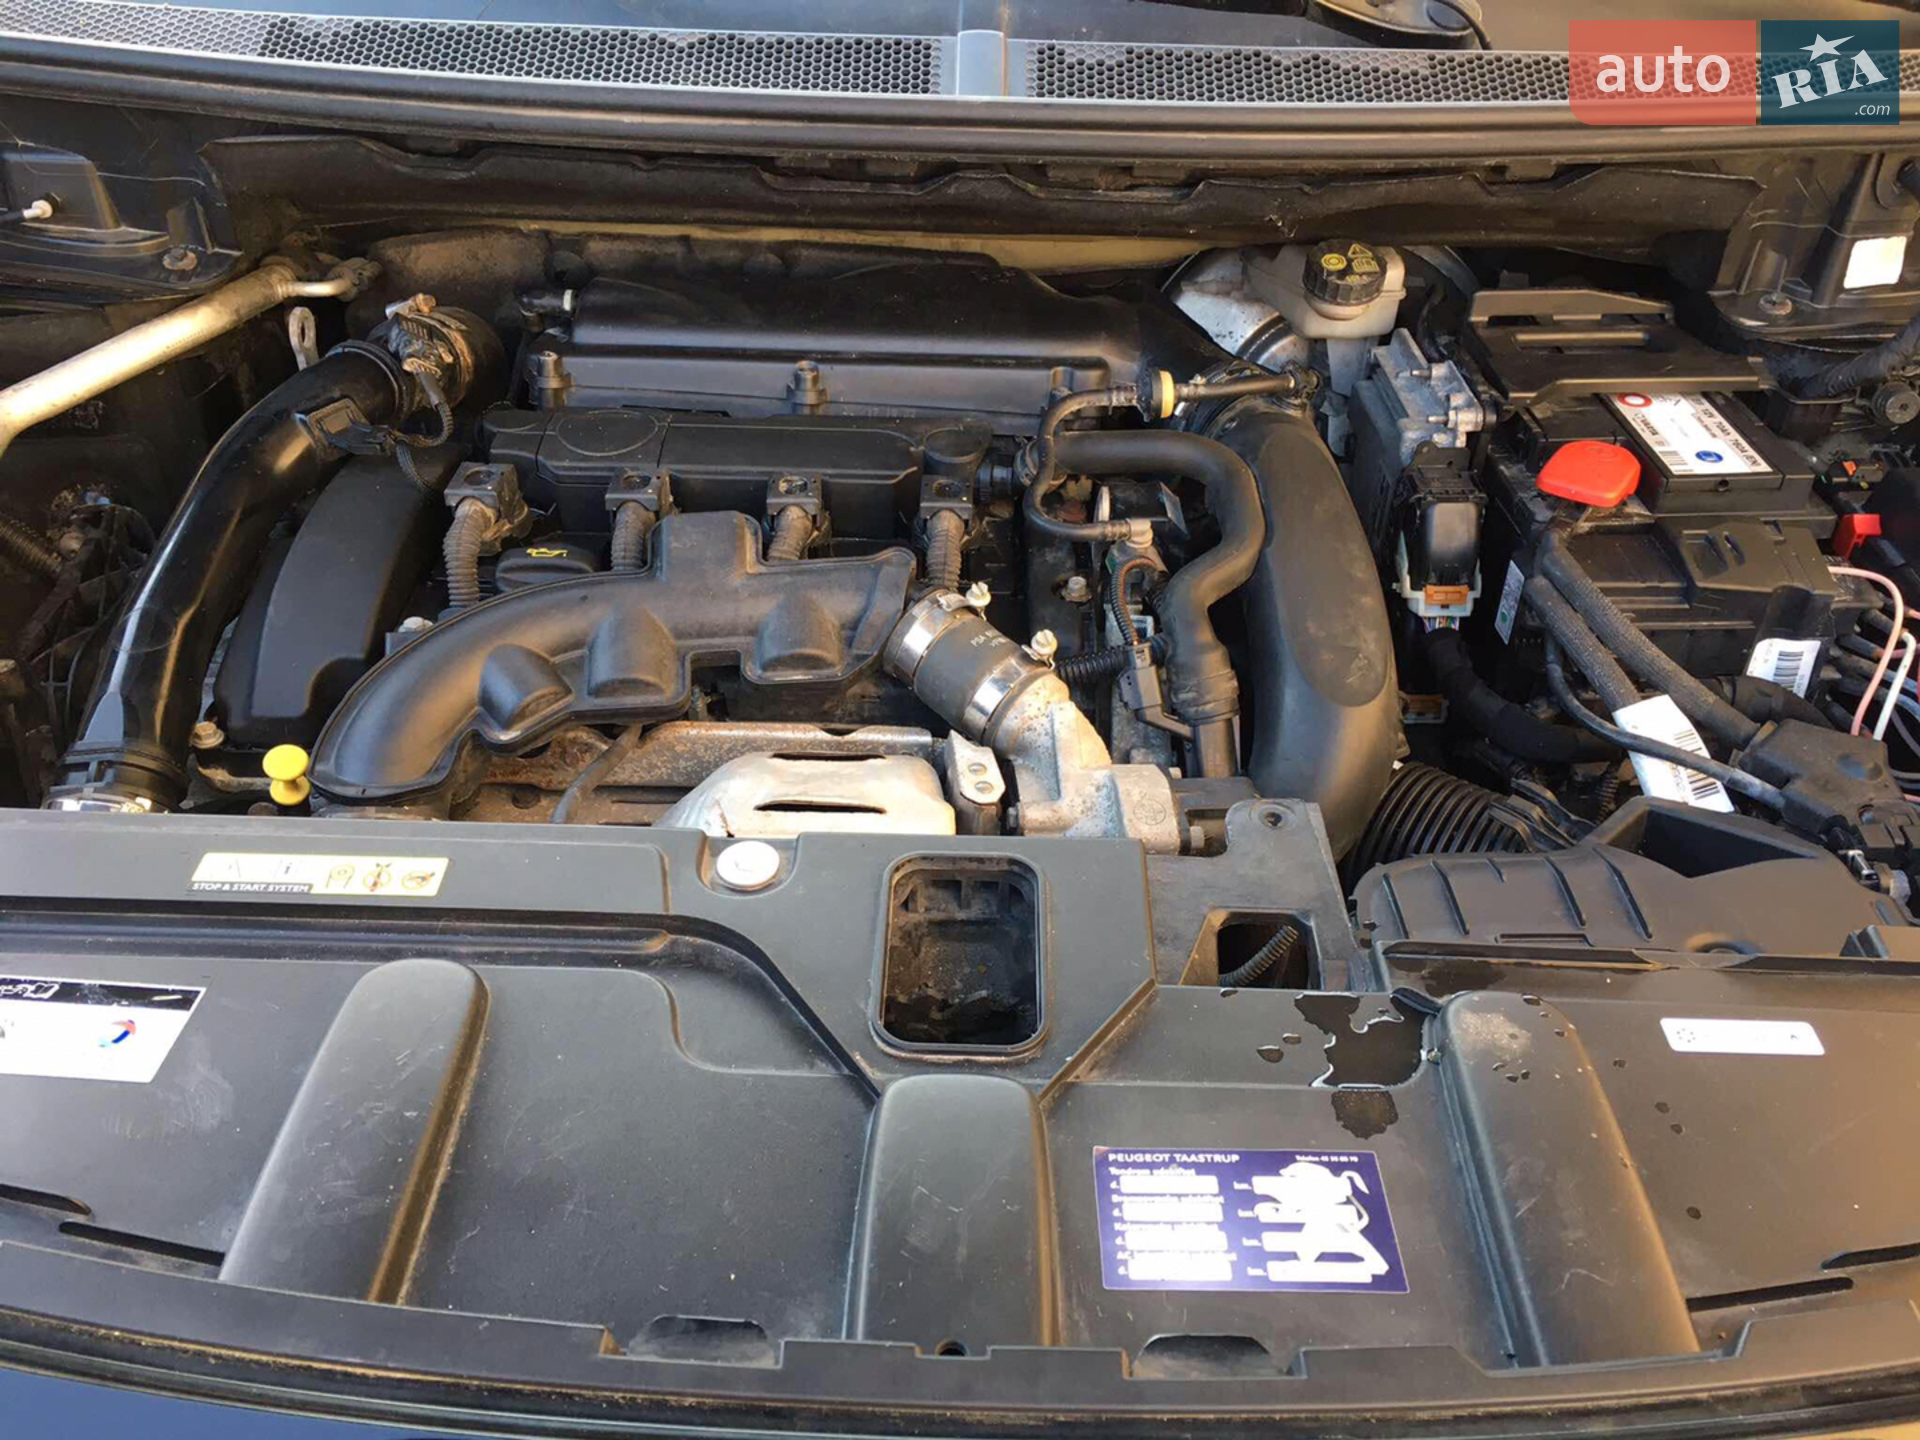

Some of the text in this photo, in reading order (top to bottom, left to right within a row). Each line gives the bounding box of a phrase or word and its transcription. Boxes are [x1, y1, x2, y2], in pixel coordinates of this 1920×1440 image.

[192, 882, 222, 892] STOP
[231, 883, 267, 893] START
[267, 884, 309, 893] SYSTEM
[1108, 1153, 1240, 1164] PEUGEOT TAASTRUP
